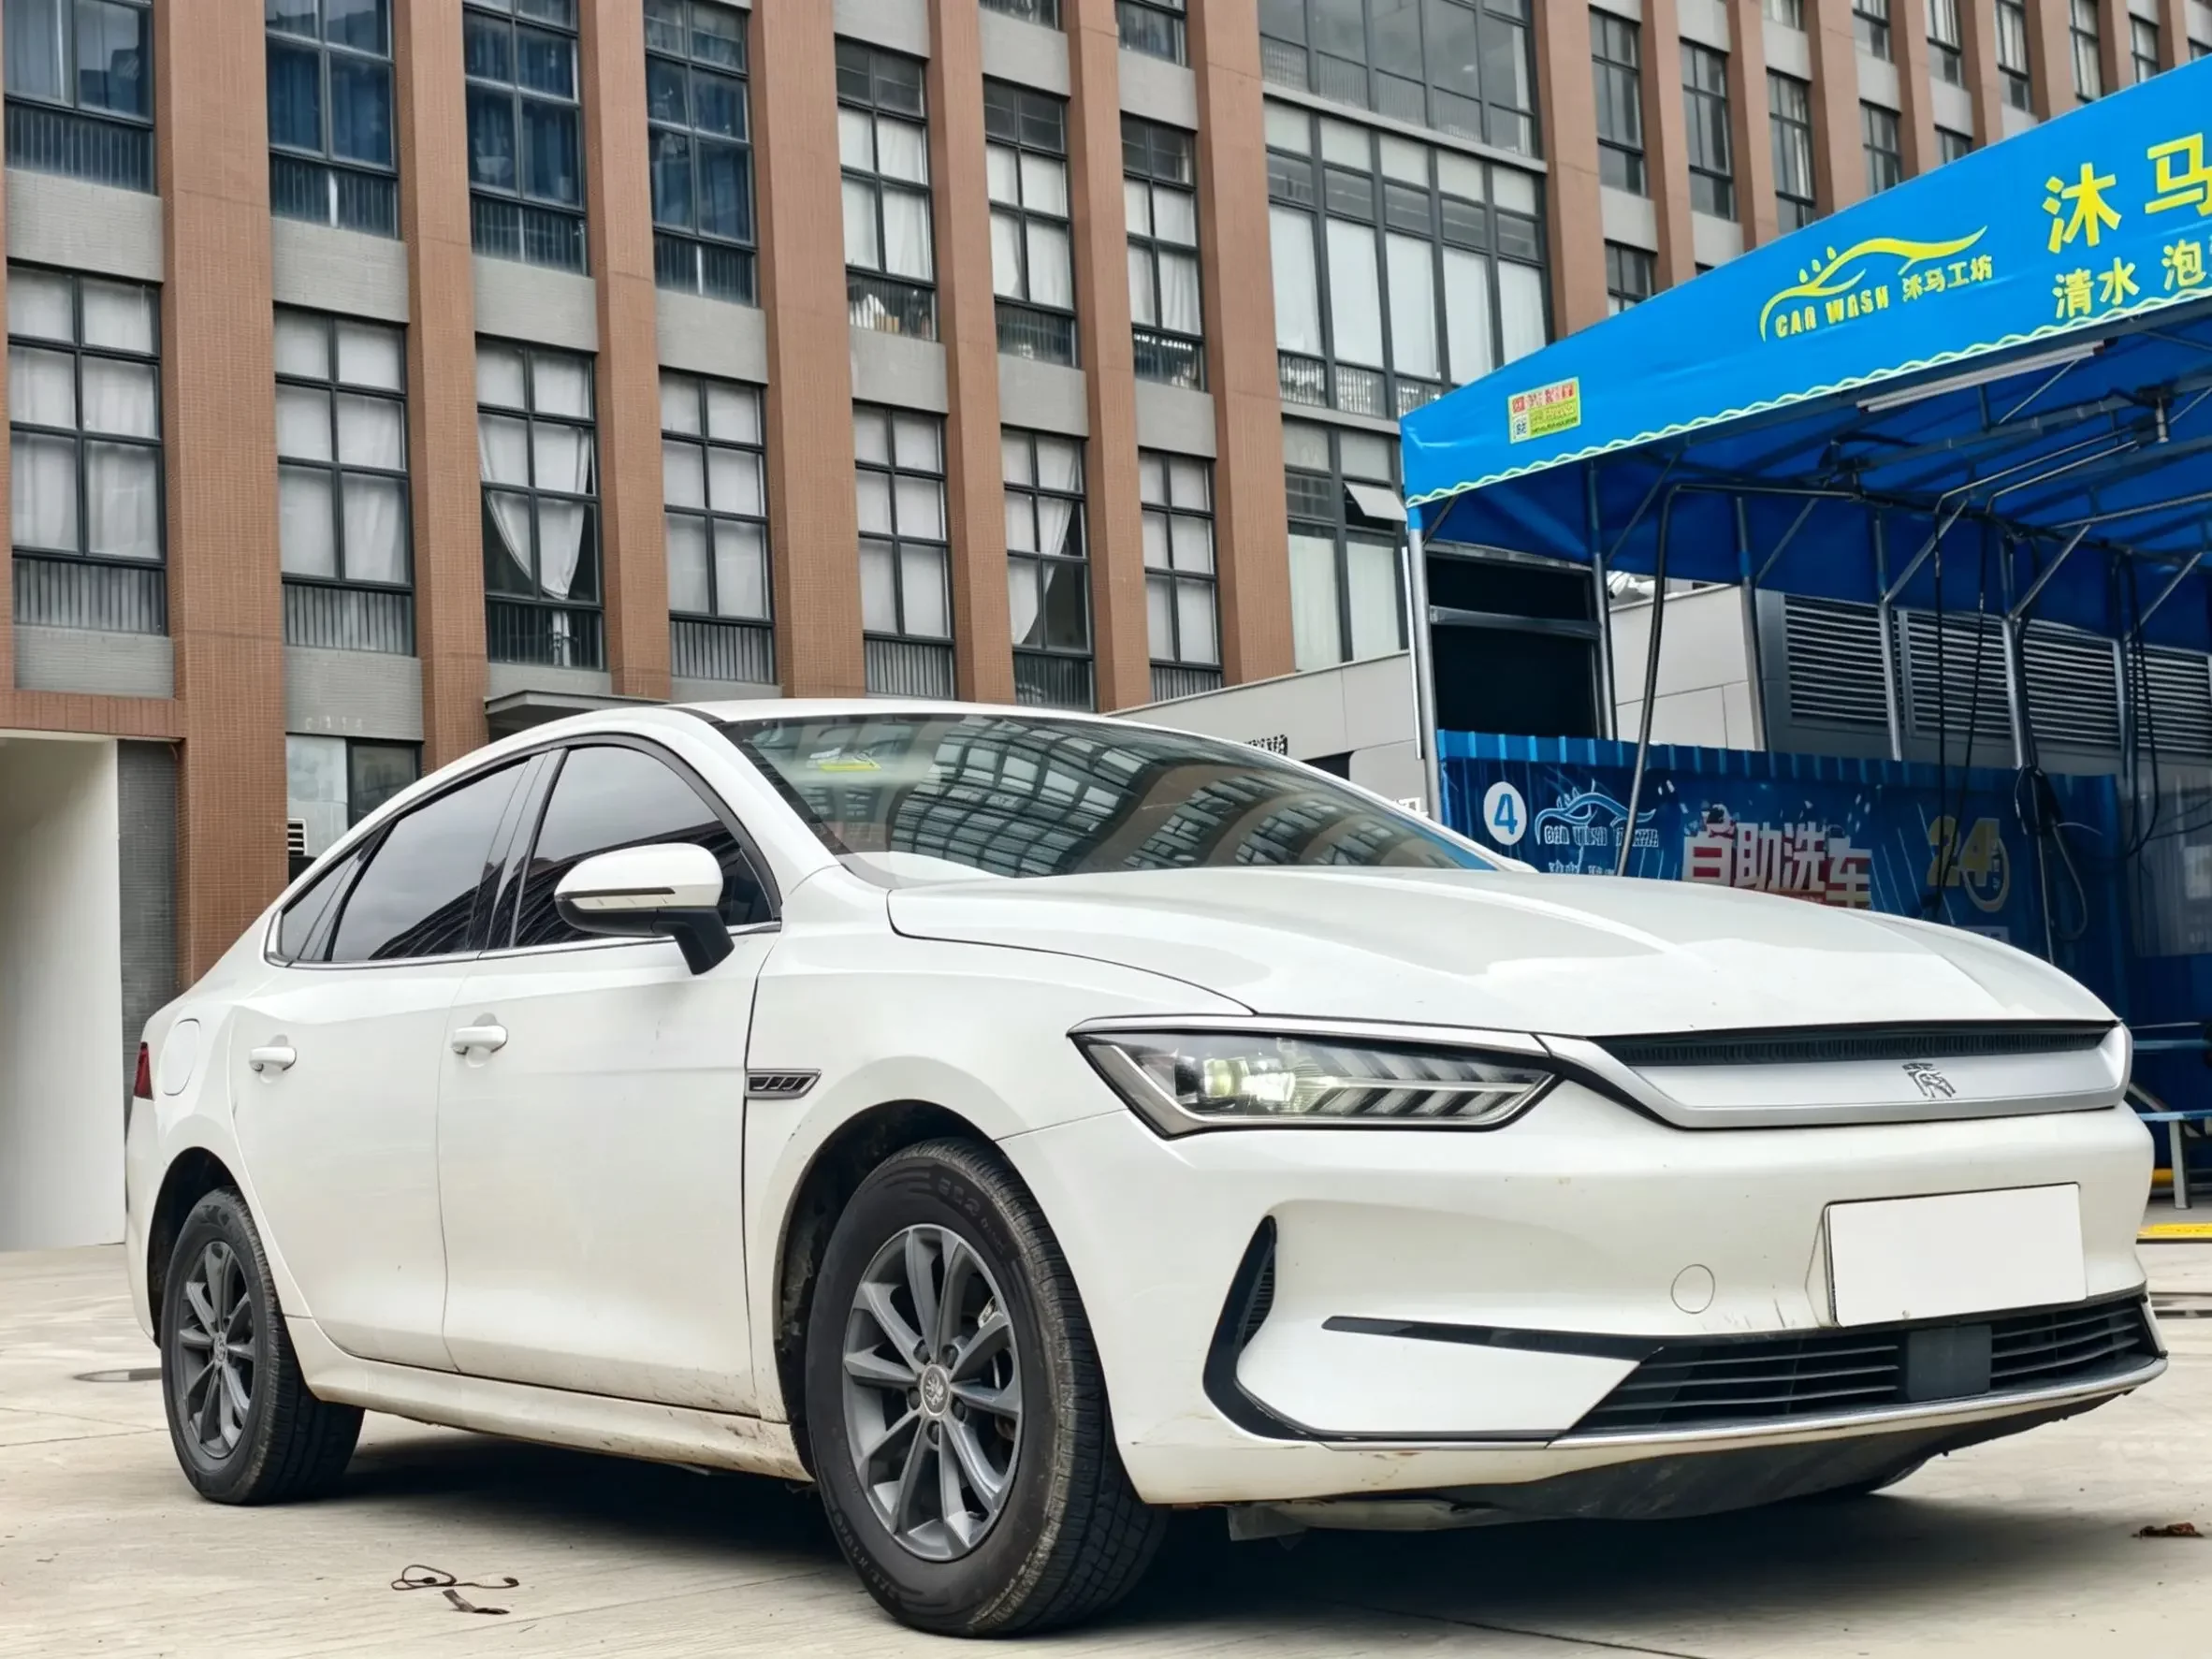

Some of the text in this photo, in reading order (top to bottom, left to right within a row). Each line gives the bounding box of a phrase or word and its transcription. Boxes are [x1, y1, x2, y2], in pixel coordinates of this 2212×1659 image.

[2042, 132, 2212, 255] 沐马
[1775, 284, 1889, 338] CAR WASH
[1901, 254, 1993, 302] 沐马工坊
[2052, 234, 2212, 319] 清水 泡
[1493, 793, 1519, 835] 4
[1927, 814, 2000, 887] 24
[1681, 821, 1872, 909] 自助洗车
